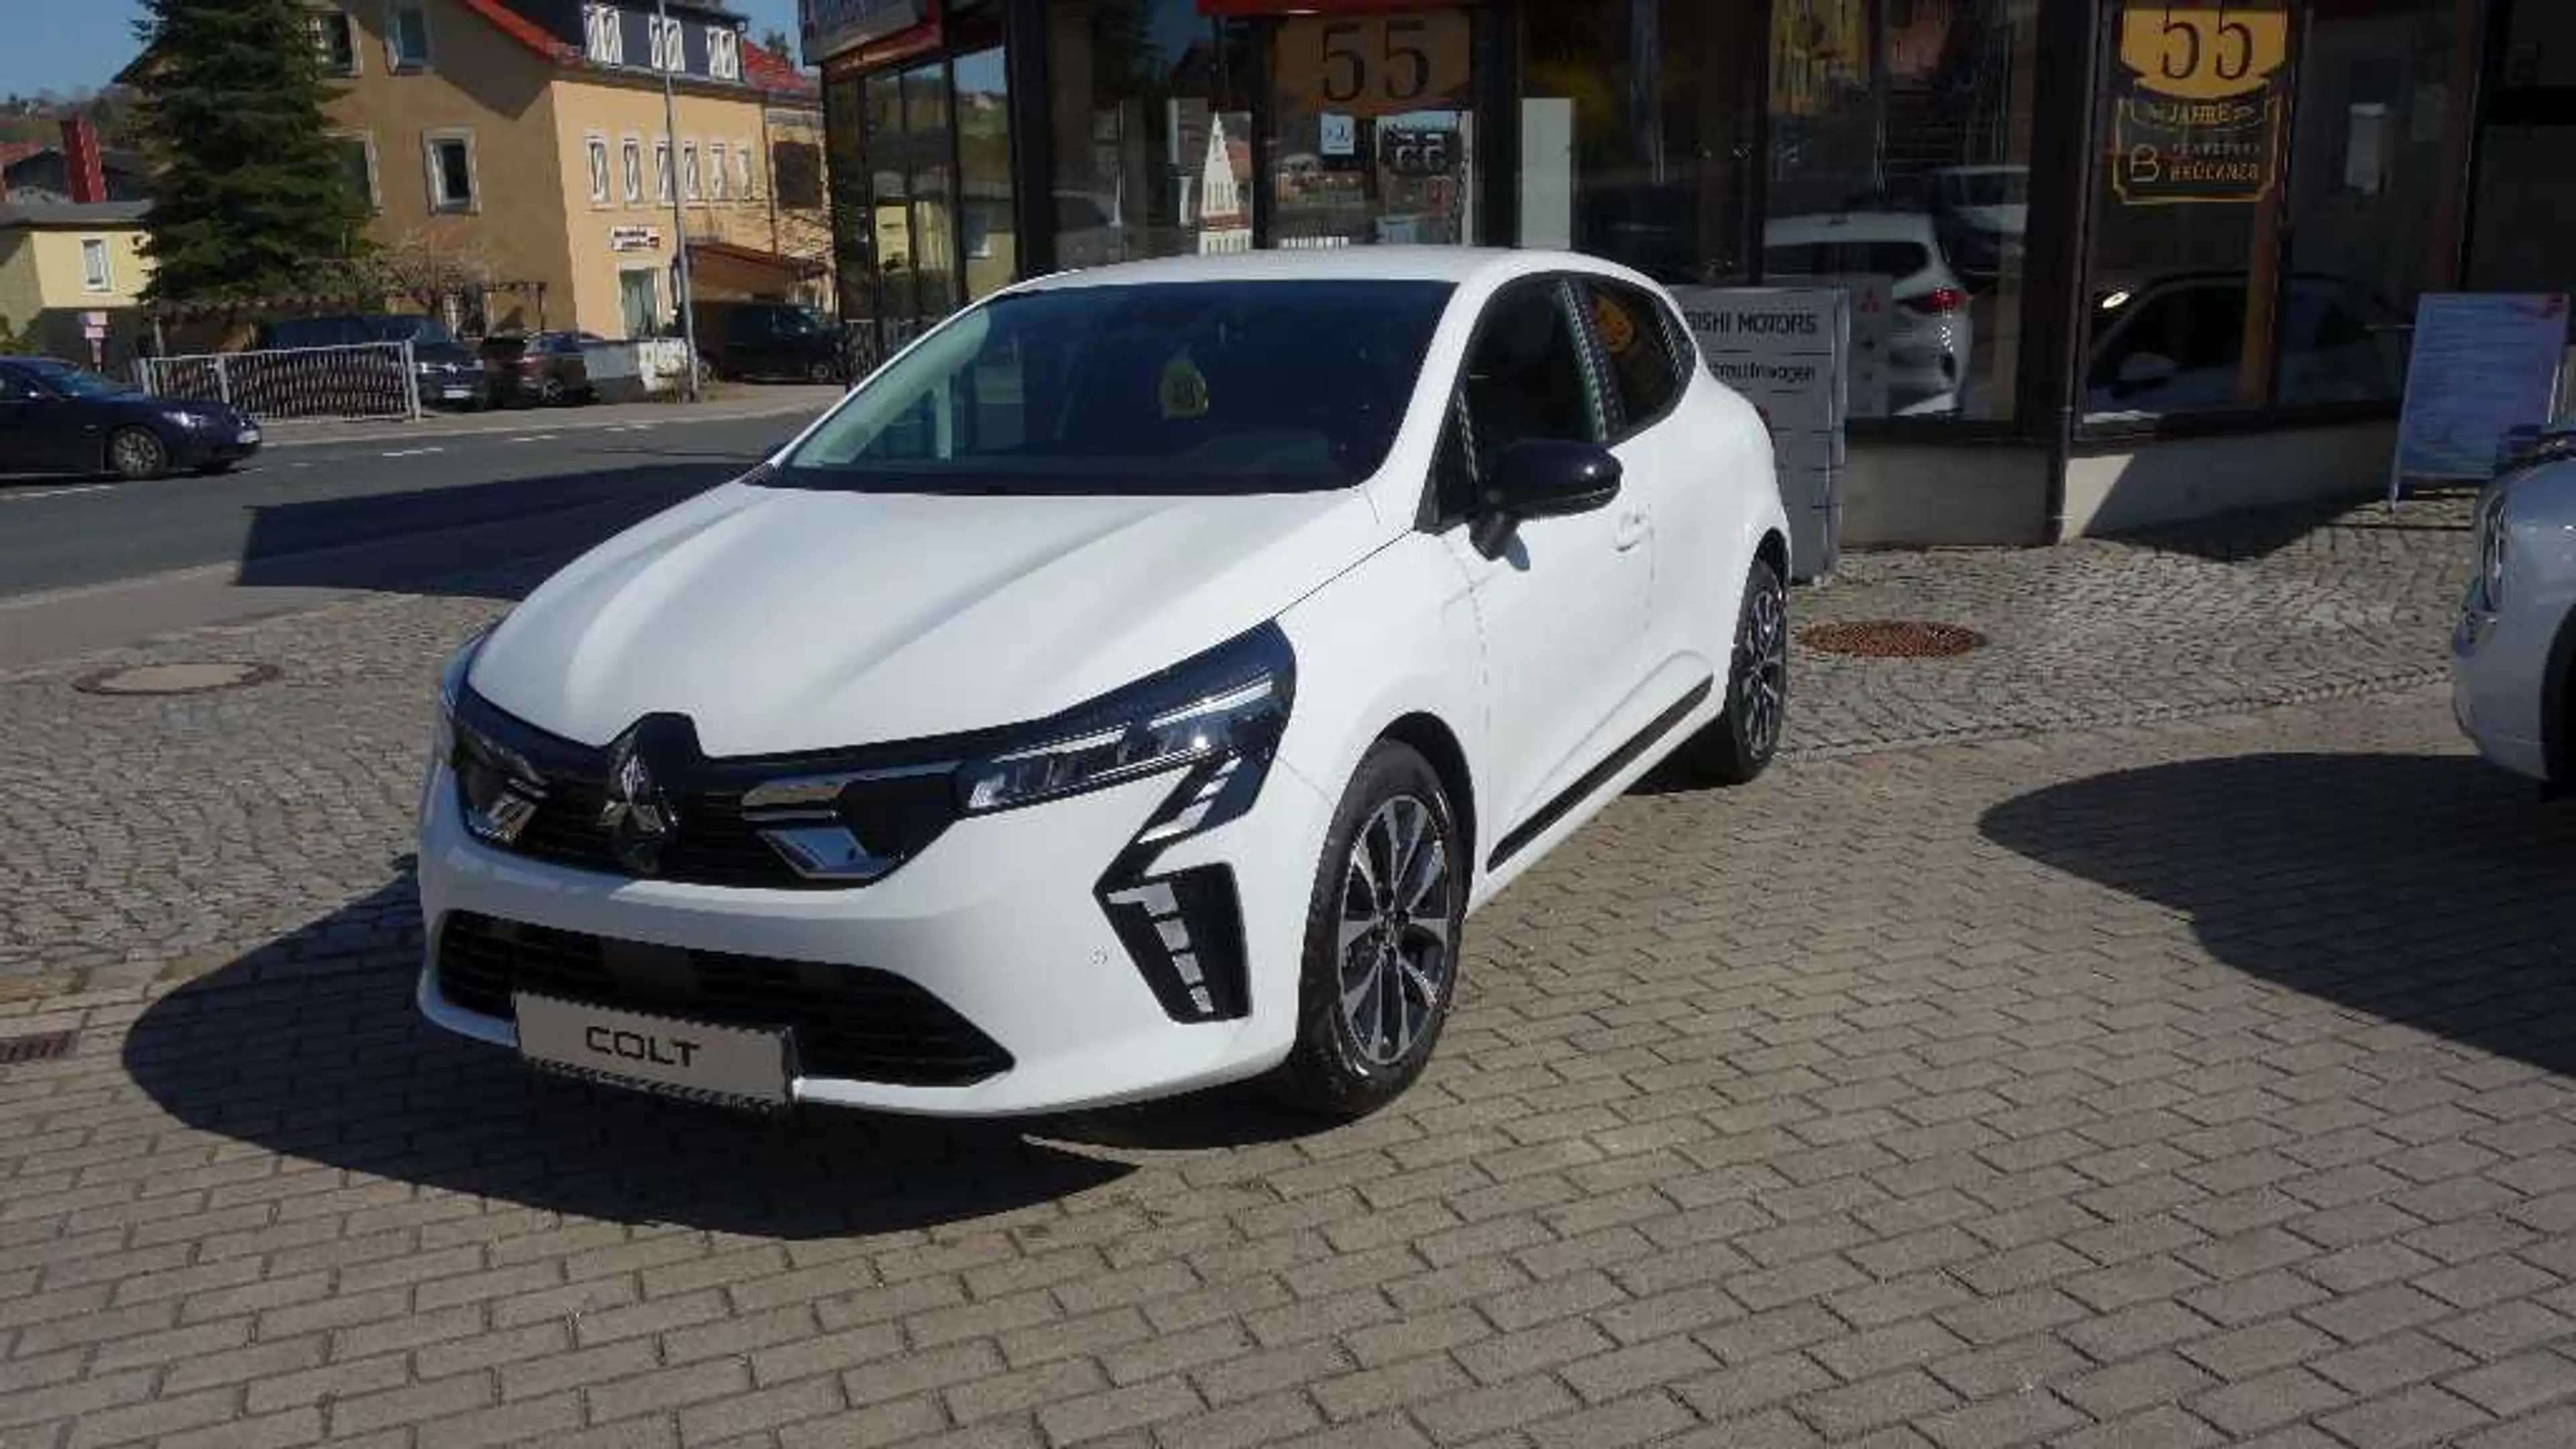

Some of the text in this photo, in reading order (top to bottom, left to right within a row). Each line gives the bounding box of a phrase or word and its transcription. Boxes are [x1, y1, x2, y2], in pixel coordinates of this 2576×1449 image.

[1322, 19, 1430, 101] 55
[1737, 311, 1817, 334] MOTORS
[586, 1026, 701, 1067] COLT
